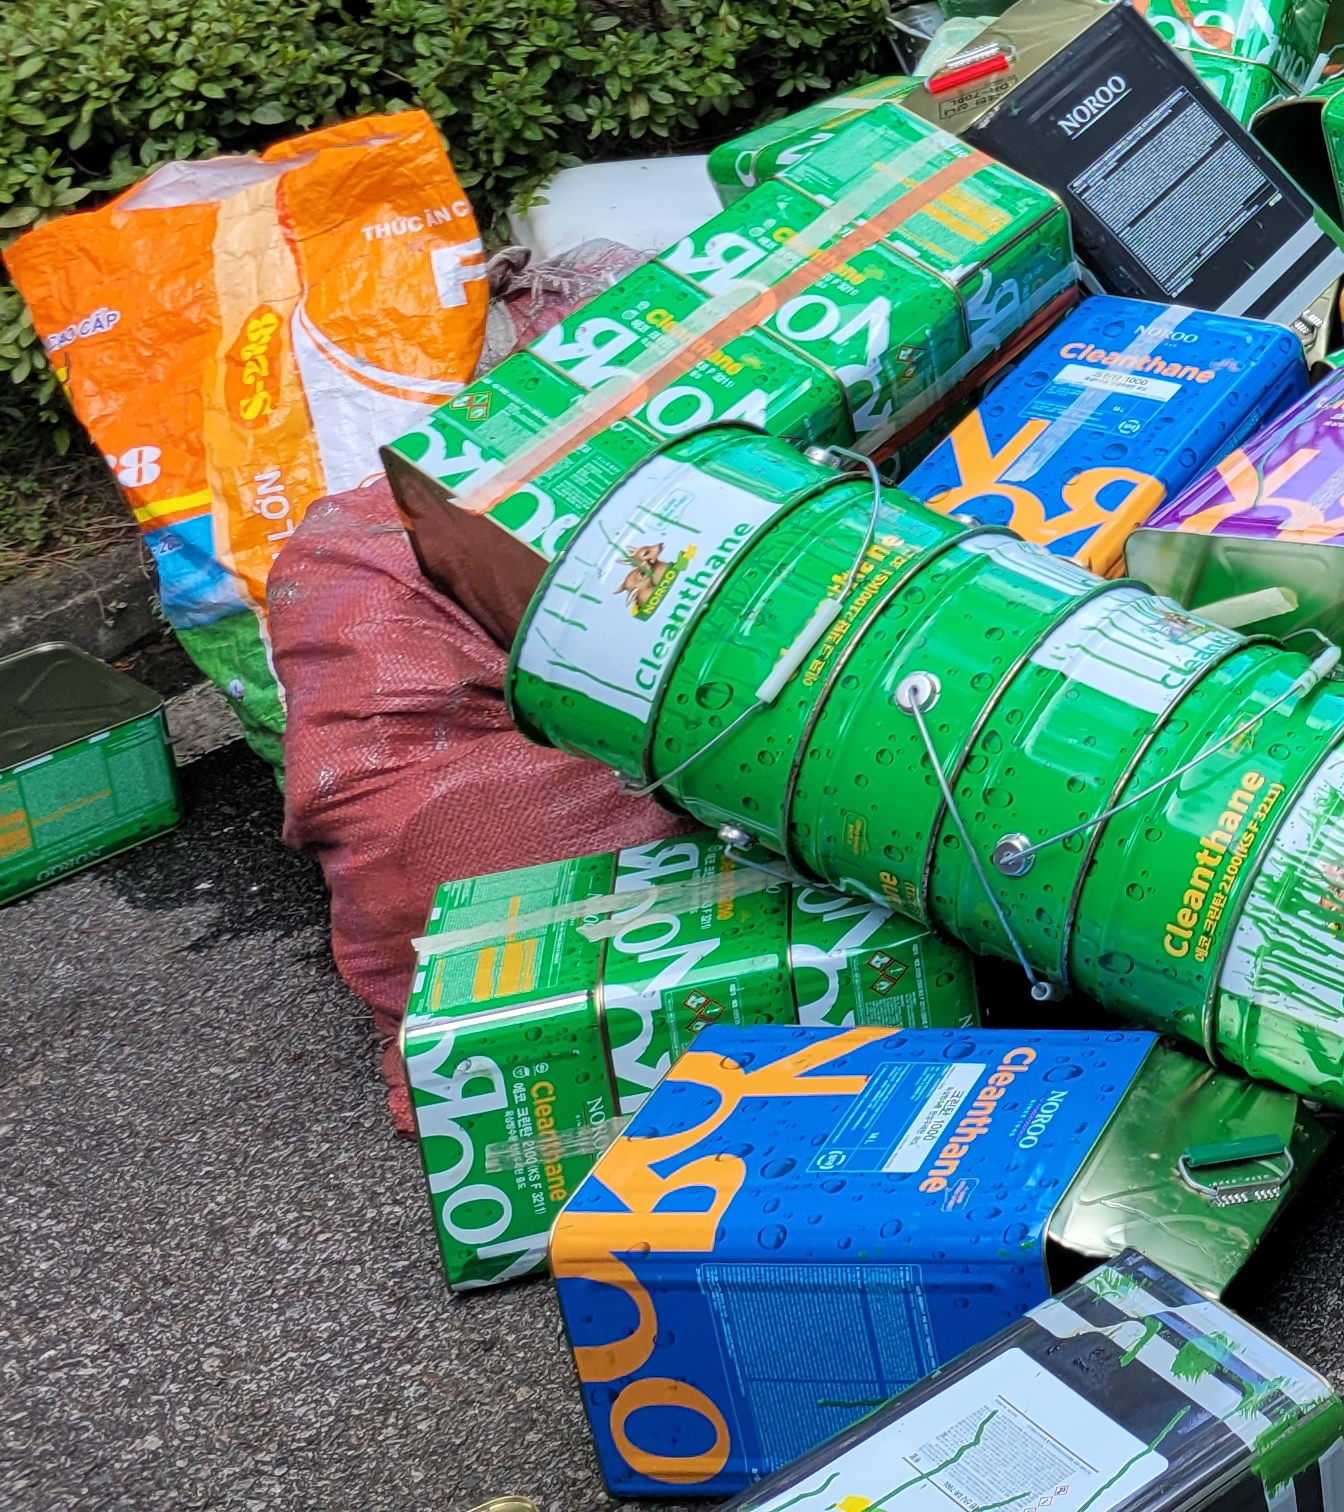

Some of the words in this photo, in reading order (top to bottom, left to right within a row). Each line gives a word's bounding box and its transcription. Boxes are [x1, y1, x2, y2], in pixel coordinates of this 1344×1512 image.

[1056, 74, 1133, 135] NOROO
[1059, 342, 1215, 383] Cleanthane
[633, 522, 752, 691] Cleanthane
[645, 568, 675, 617] NOROO
[1258, 783, 1286, 827] 3211)
[1163, 771, 1265, 958] Cleanthane
[1202, 893, 1228, 938] 크린탄
[1194, 934, 1213, 963] 에코
[512, 1082, 528, 1105] 에코
[940, 1089, 964, 1118] 크린탄
[516, 1106, 532, 1139] 크린탄
[919, 1047, 1037, 1195] Cleanthane
[922, 1116, 946, 1143] 1000
[1018, 1088, 1068, 1149] NOROO
[531, 1081, 568, 1202] Cleanthane
[534, 1188, 550, 1216] 3211)
